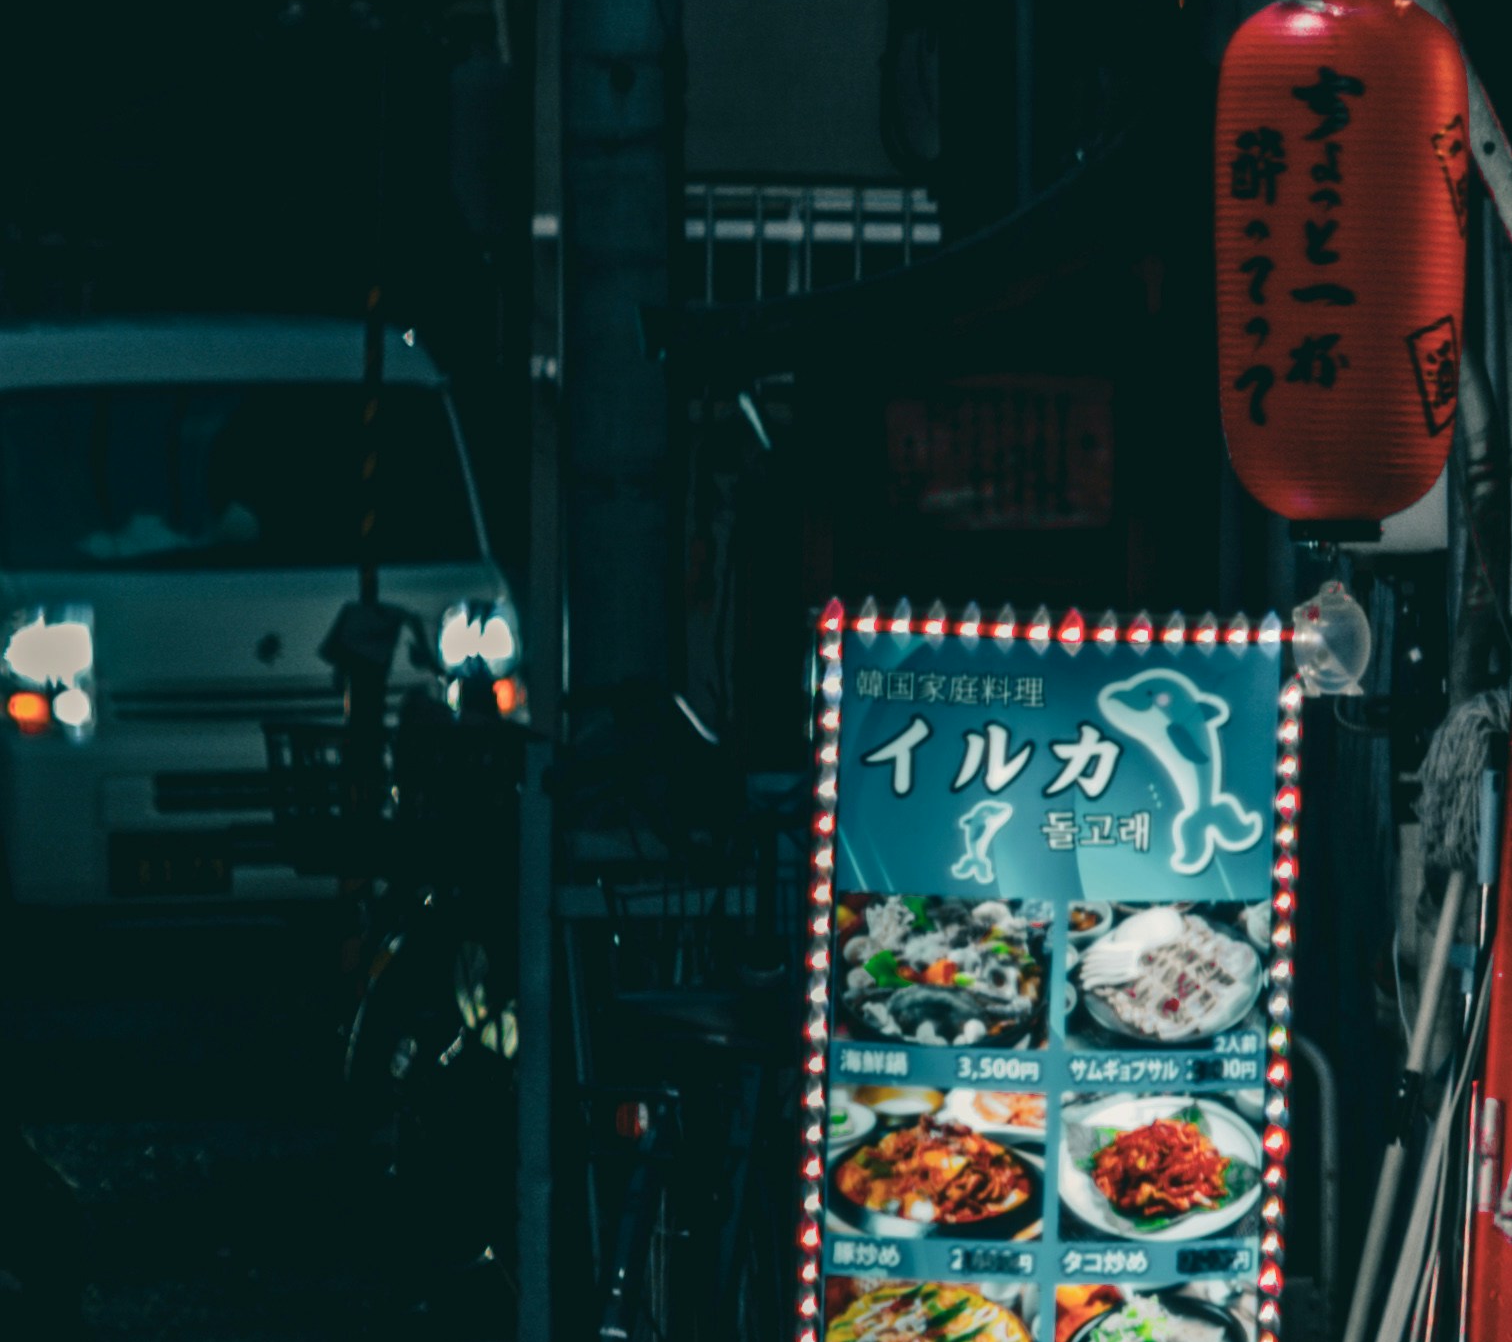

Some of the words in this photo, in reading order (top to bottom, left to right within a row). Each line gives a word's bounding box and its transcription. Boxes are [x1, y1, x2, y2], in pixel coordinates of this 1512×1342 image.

[854, 670, 1046, 709] 韓国家庭料理
[861, 717, 1124, 798] イルカ
[1040, 811, 1152, 853] 돌고래
[1213, 1032, 1257, 1056] 2人前
[957, 1056, 1040, 1083] 3,500円
[1061, 1250, 1149, 1275] タコ炒め
